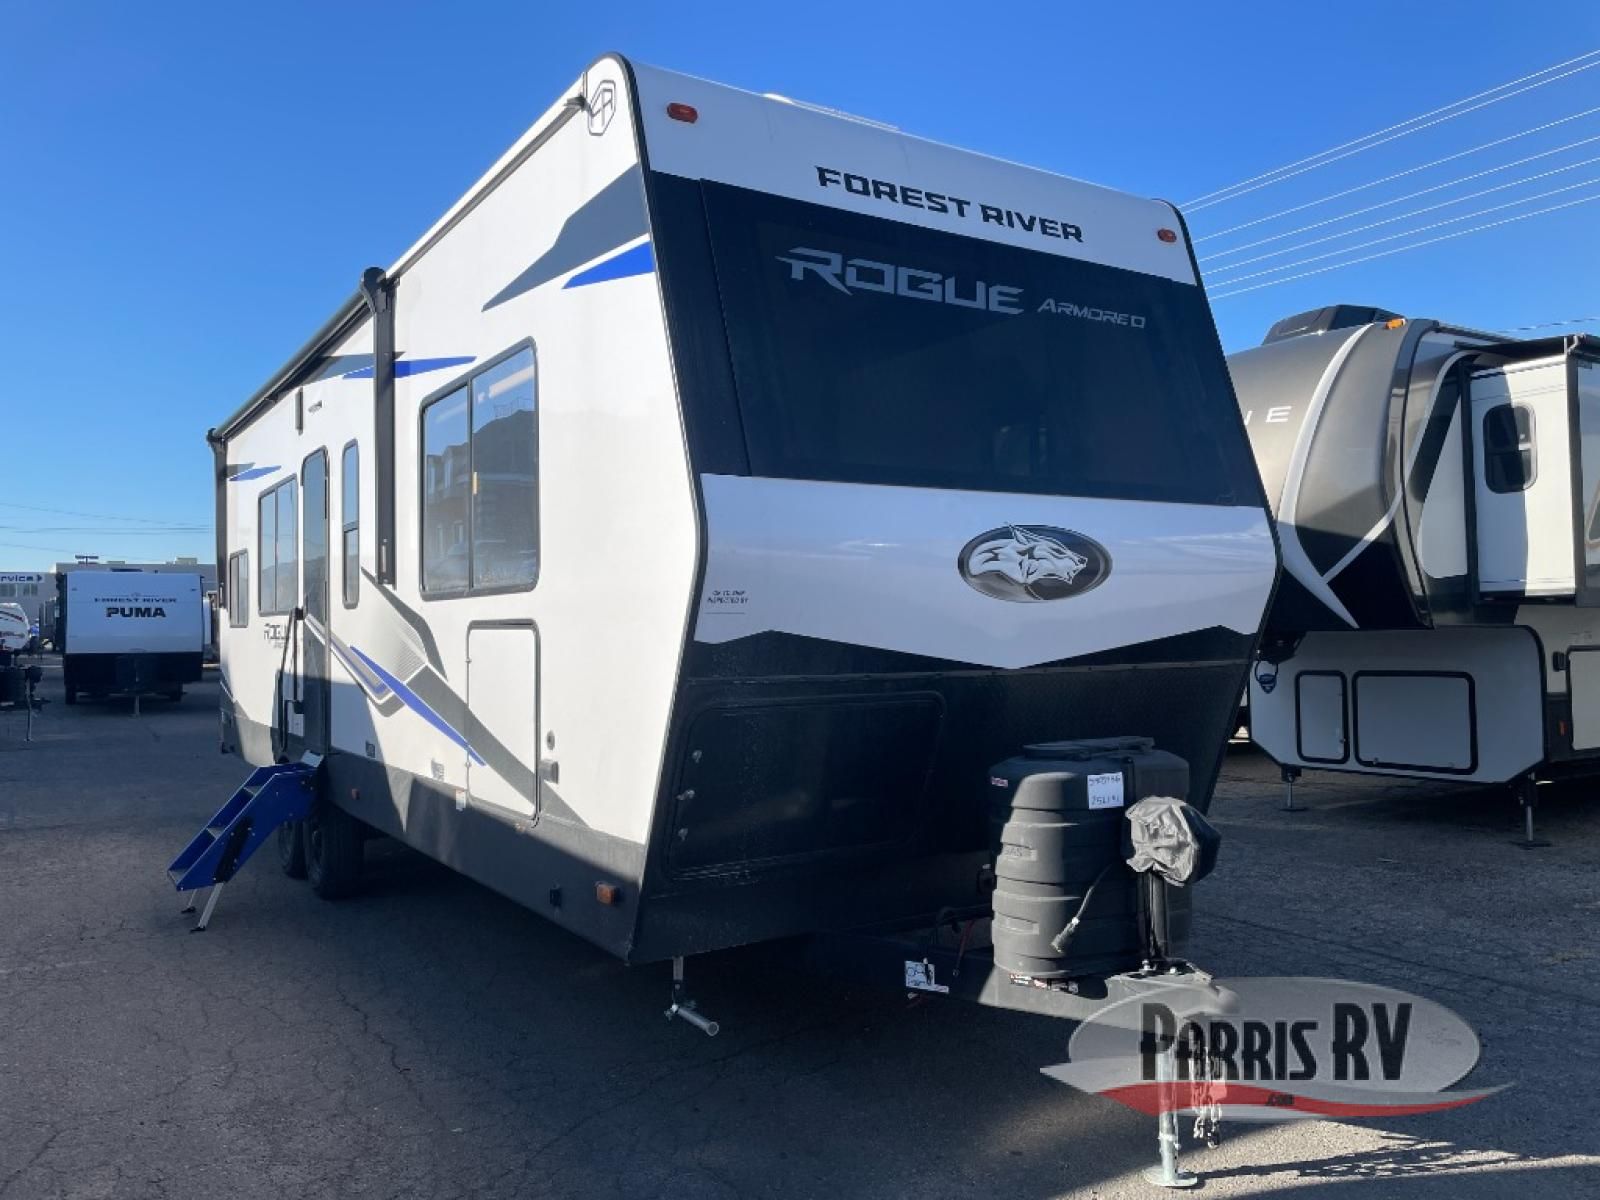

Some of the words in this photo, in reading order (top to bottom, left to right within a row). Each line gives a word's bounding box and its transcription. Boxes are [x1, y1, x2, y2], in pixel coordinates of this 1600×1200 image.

[815, 165, 971, 219] FOREST
[978, 203, 1083, 243] RIVER
[775, 246, 1024, 315] ROGUE
[1036, 297, 1145, 329] ARMORED
[105, 607, 167, 618] PUMA
